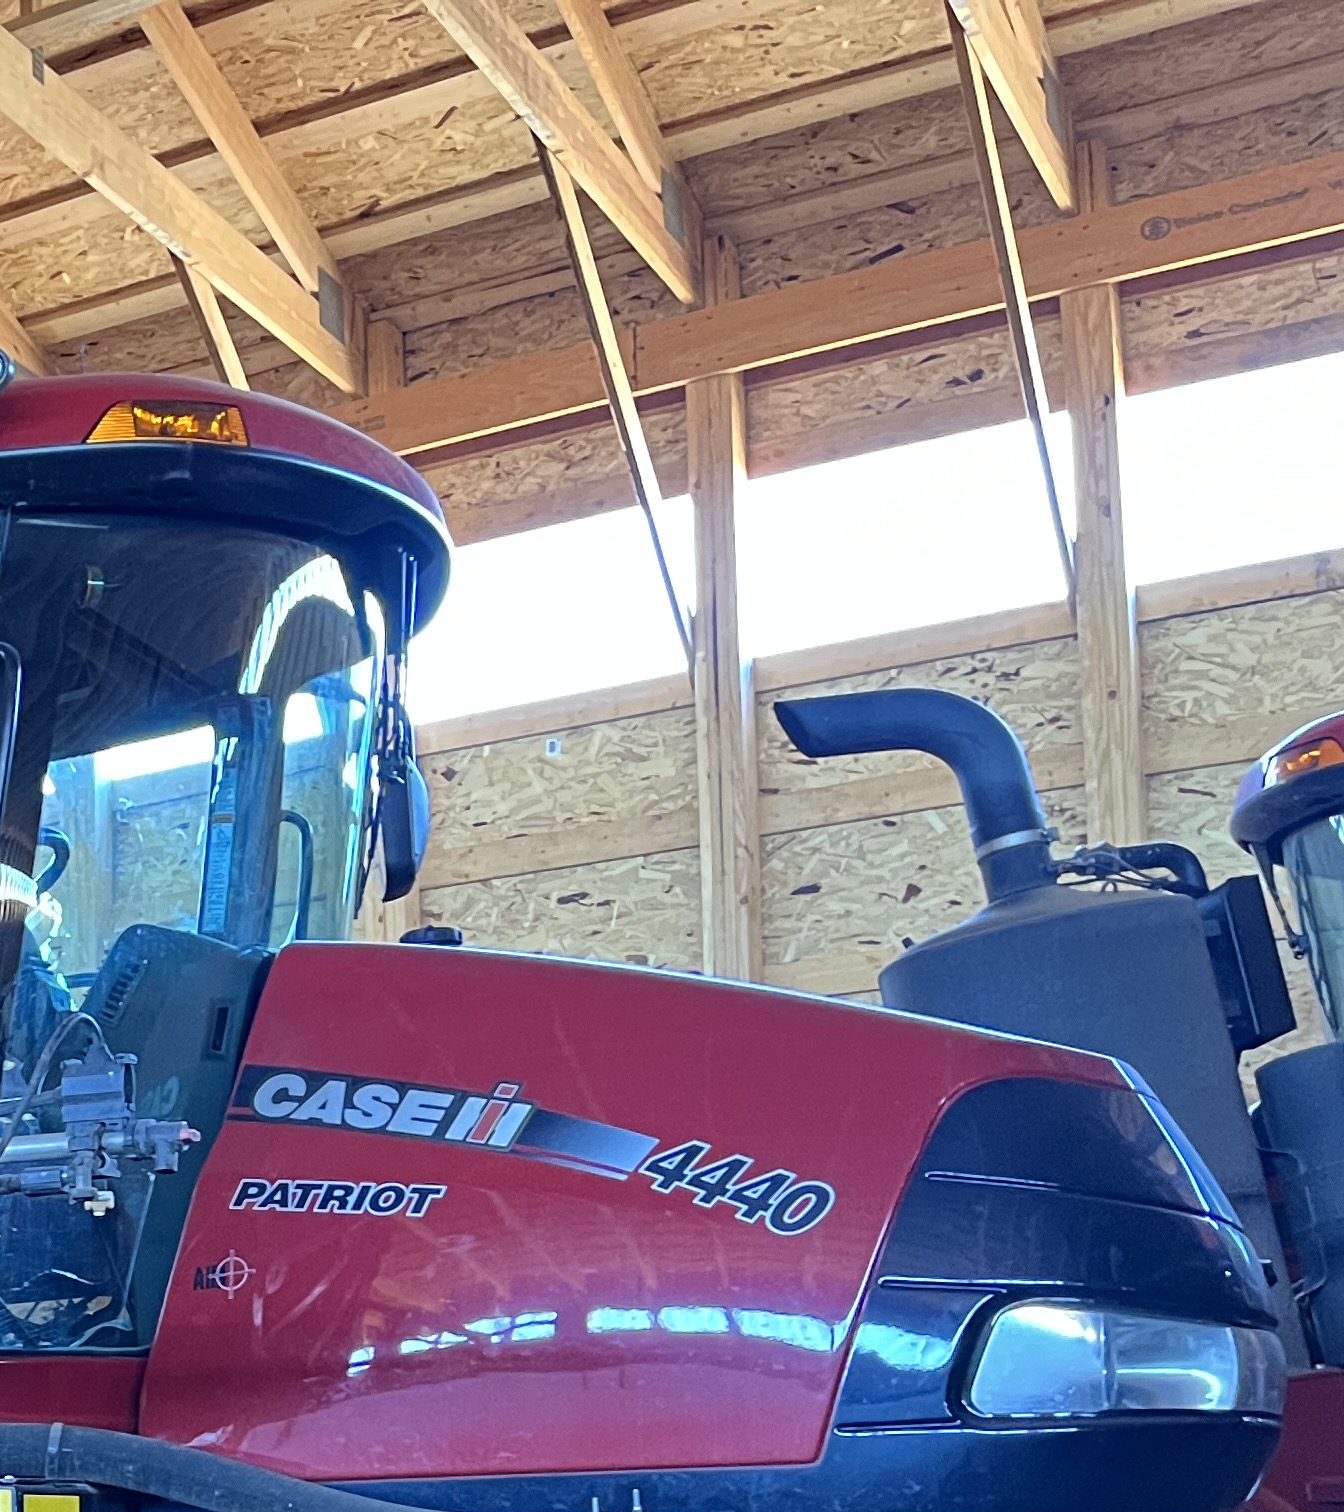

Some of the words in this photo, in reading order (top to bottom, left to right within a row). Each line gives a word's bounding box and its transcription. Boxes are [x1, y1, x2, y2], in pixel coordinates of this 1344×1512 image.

[252, 1072, 450, 1138] CASE
[229, 1178, 445, 1218] PATRIOT
[639, 1138, 837, 1236] 4440
